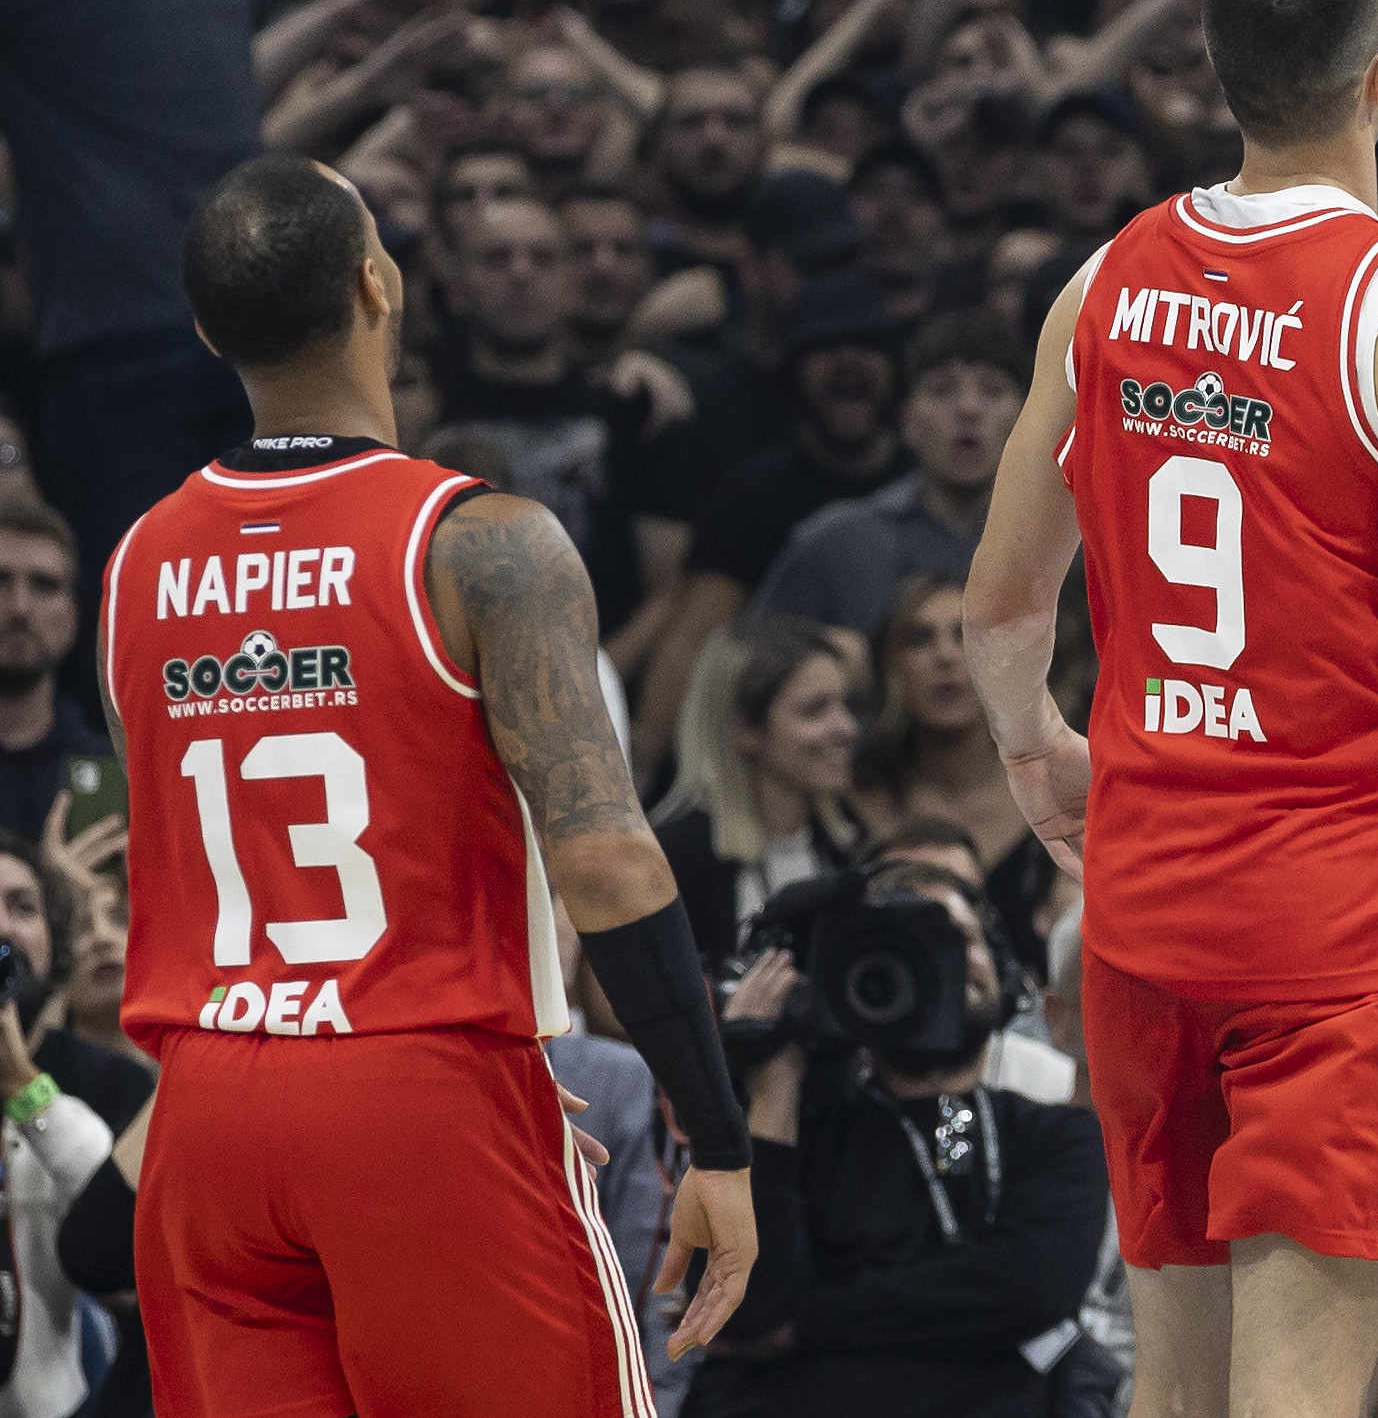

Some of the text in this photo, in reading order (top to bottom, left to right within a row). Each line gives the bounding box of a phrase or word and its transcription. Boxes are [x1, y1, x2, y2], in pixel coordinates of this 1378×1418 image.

[1108, 286, 1305, 371] MITROVIĆ
[253, 436, 333, 450] NIKE PRO
[1120, 378, 1274, 443] SOCCER
[1122, 417, 1271, 458] WWW.SOCCERBET.RS
[156, 545, 356, 620] NAPIER
[1147, 455, 1246, 671] 9
[163, 643, 357, 702] SOCCER
[167, 690, 359, 720] WWW.SOCCERBET.RS
[180, 732, 389, 968] 13
